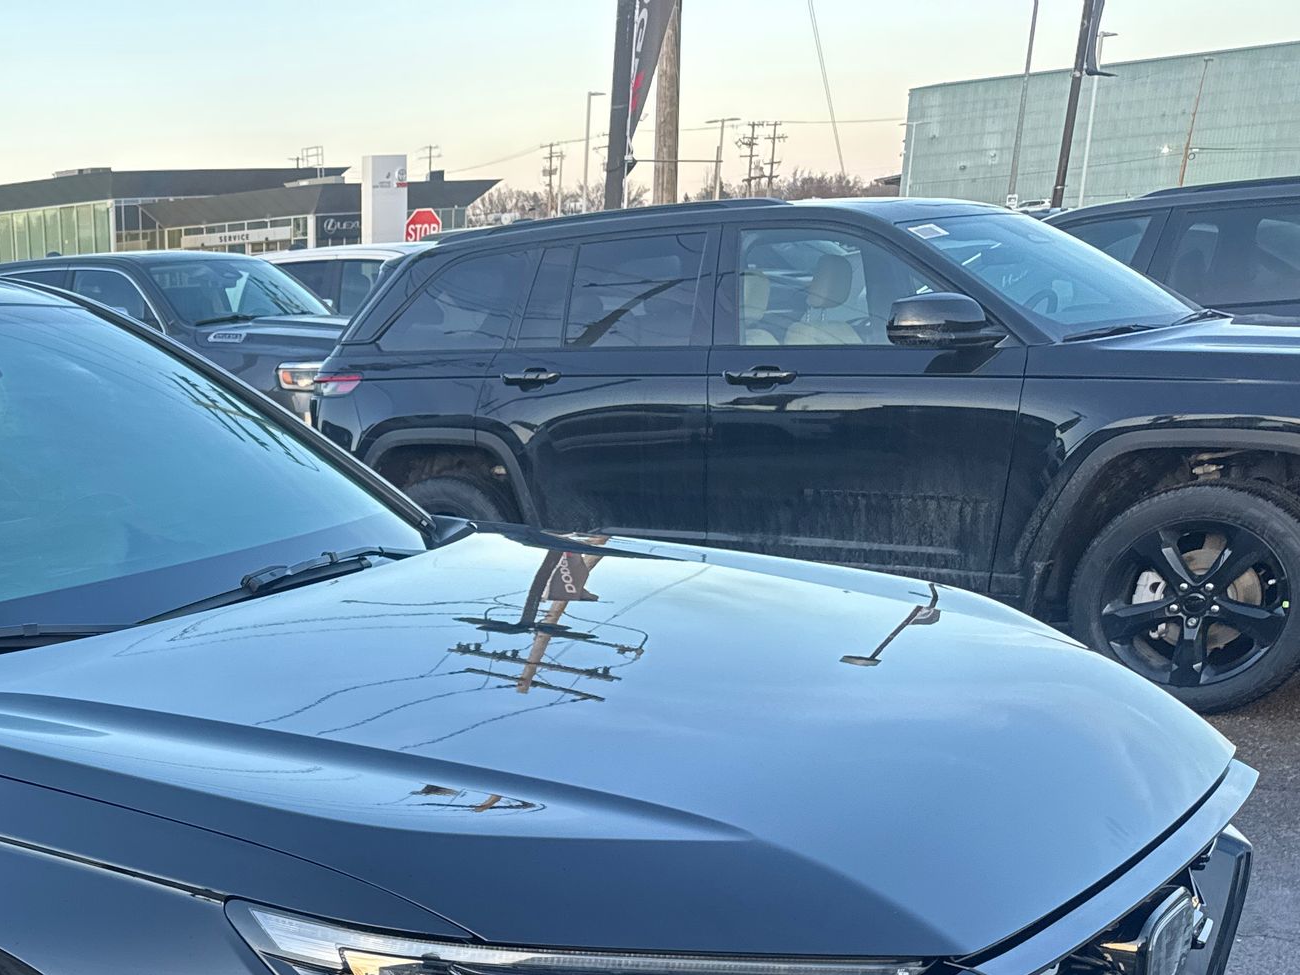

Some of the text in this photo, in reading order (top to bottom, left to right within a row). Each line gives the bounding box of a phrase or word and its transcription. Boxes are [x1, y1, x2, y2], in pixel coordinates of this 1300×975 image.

[337, 220, 360, 230] LEX
[407, 223, 439, 242] STOP
[219, 233, 250, 243] SERVICE
